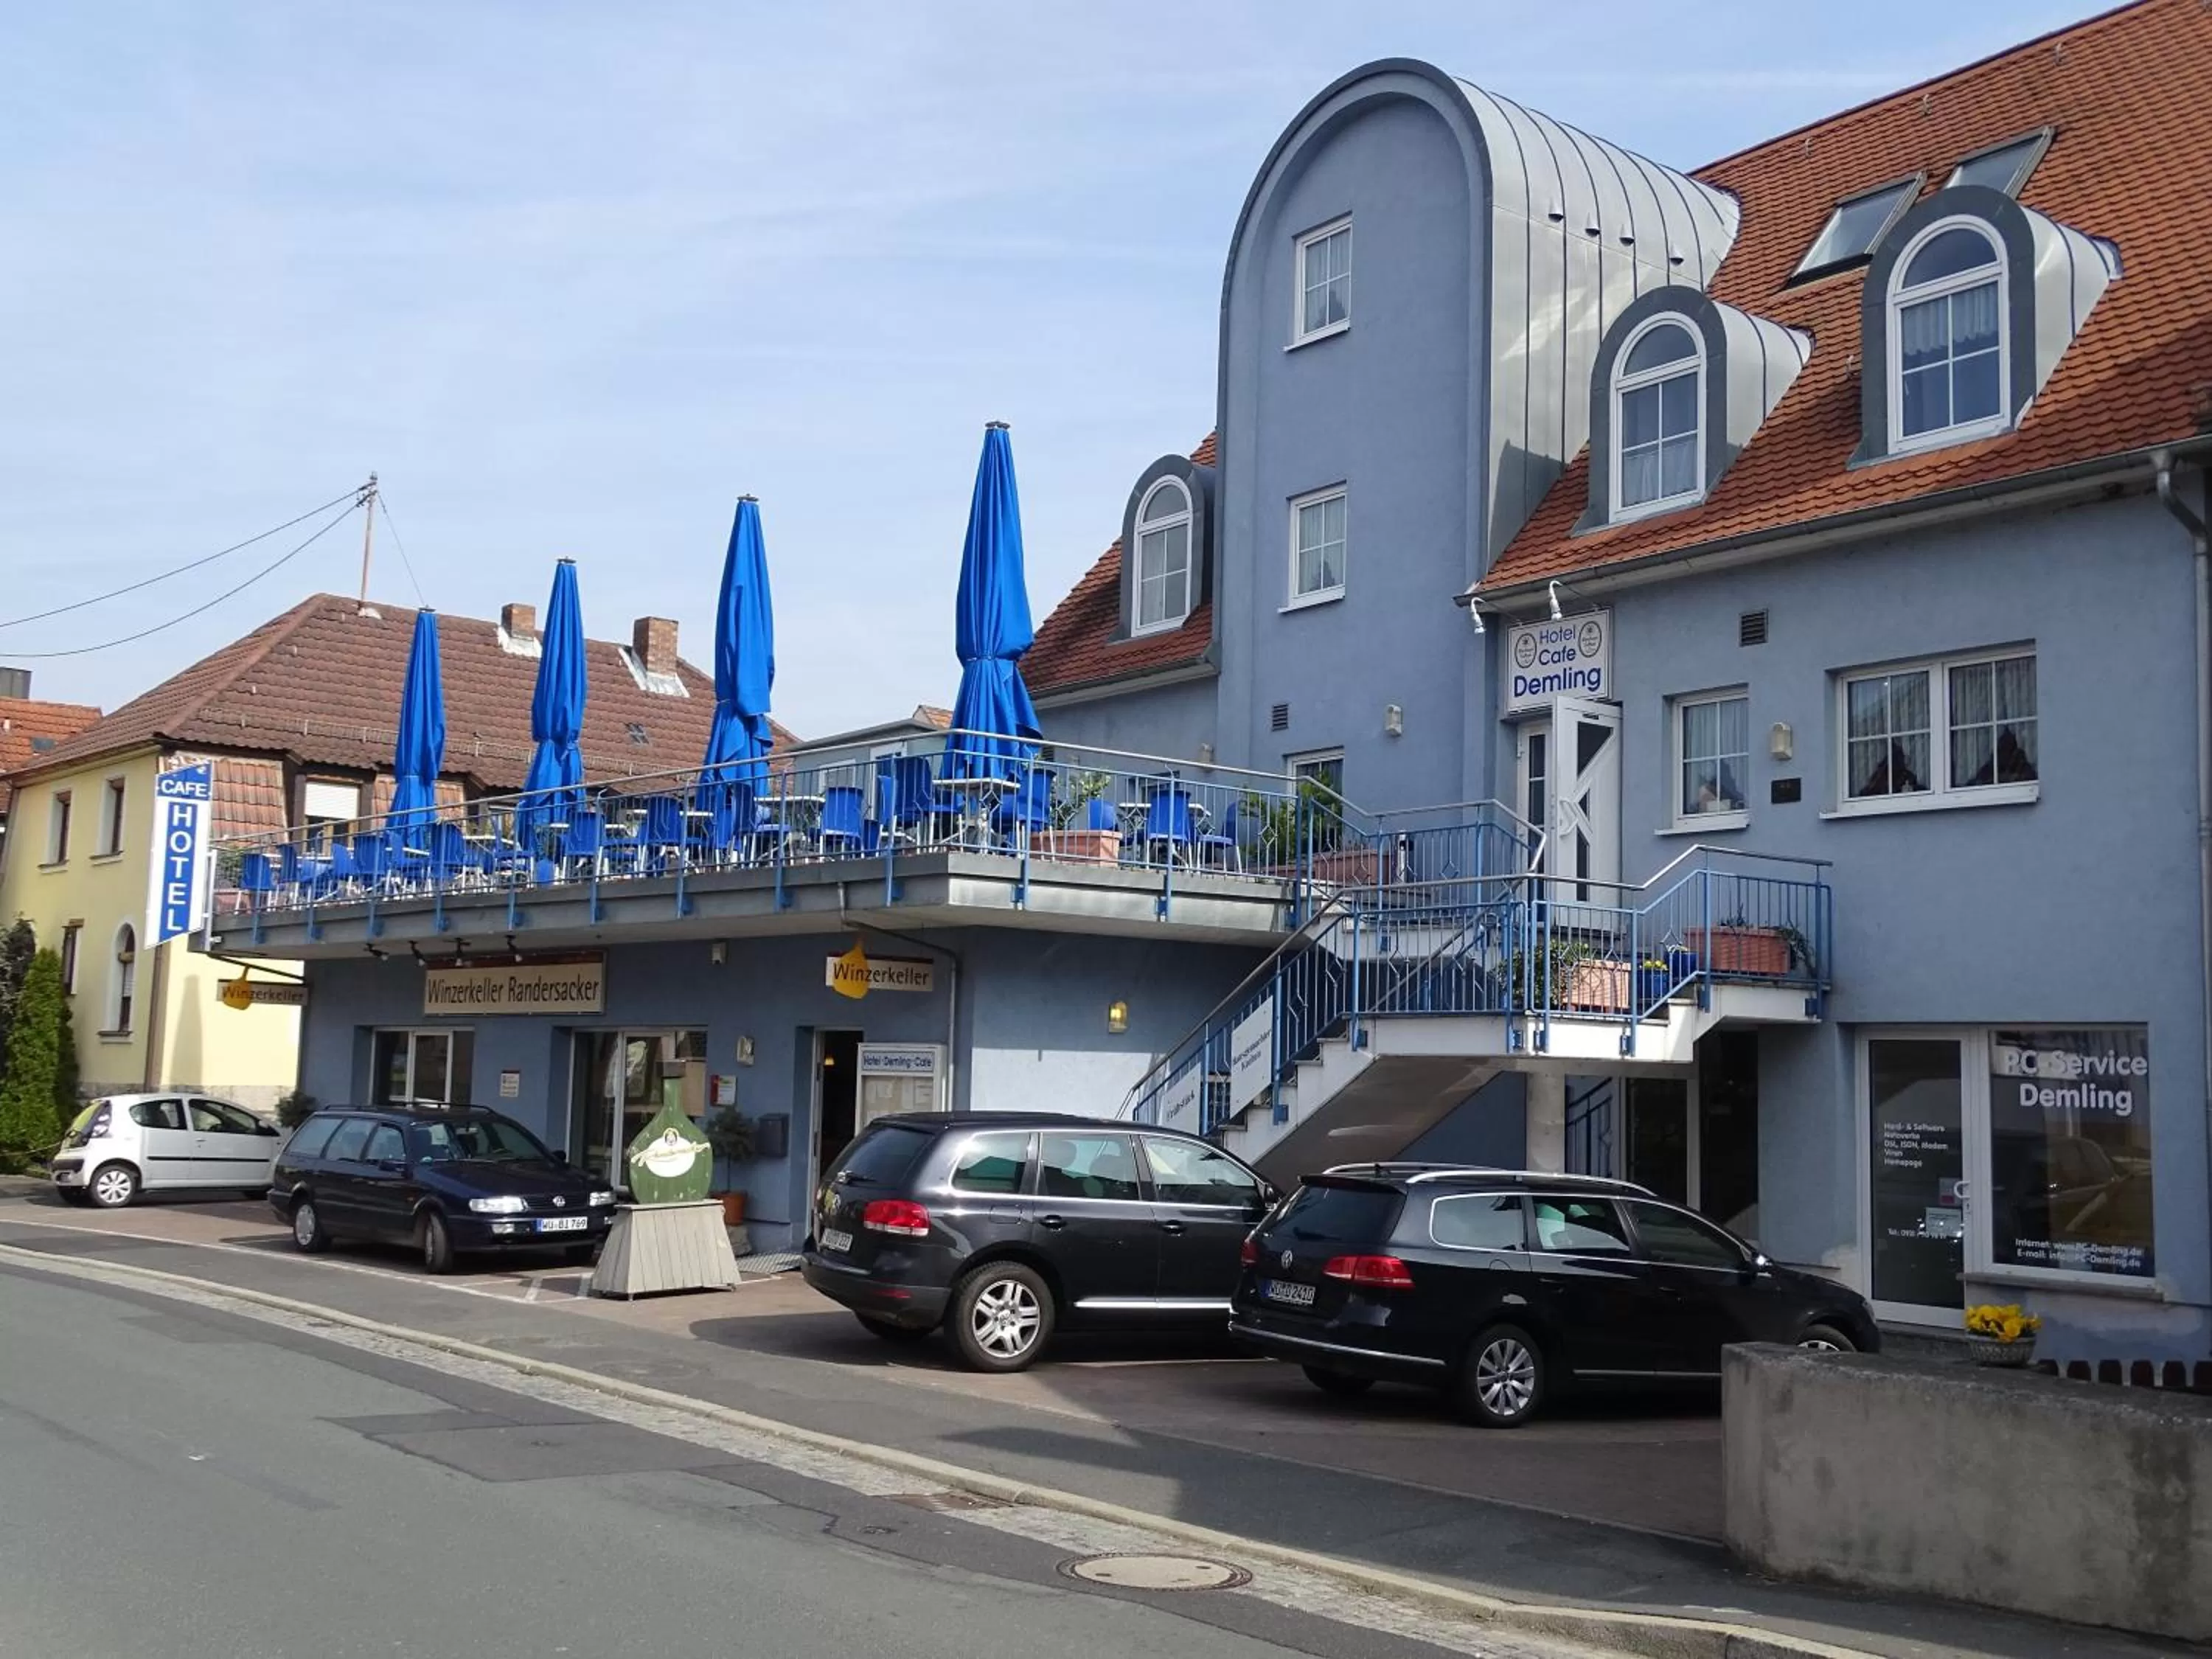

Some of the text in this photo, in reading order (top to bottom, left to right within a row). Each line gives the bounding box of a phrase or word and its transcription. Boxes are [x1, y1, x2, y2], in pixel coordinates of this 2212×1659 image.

[1540, 625, 1576, 644] Hotel
[1539, 645, 1576, 665] Cafe
[1514, 667, 1601, 698] Demling
[161, 779, 208, 797] CAFE
[167, 804, 193, 931] HOTEL
[833, 961, 929, 986] Winzerkeller
[223, 986, 304, 1001] Winzerkeller
[428, 974, 599, 1004] Winzerkeller Randersacker
[2020, 1083, 2132, 1116] Demling
